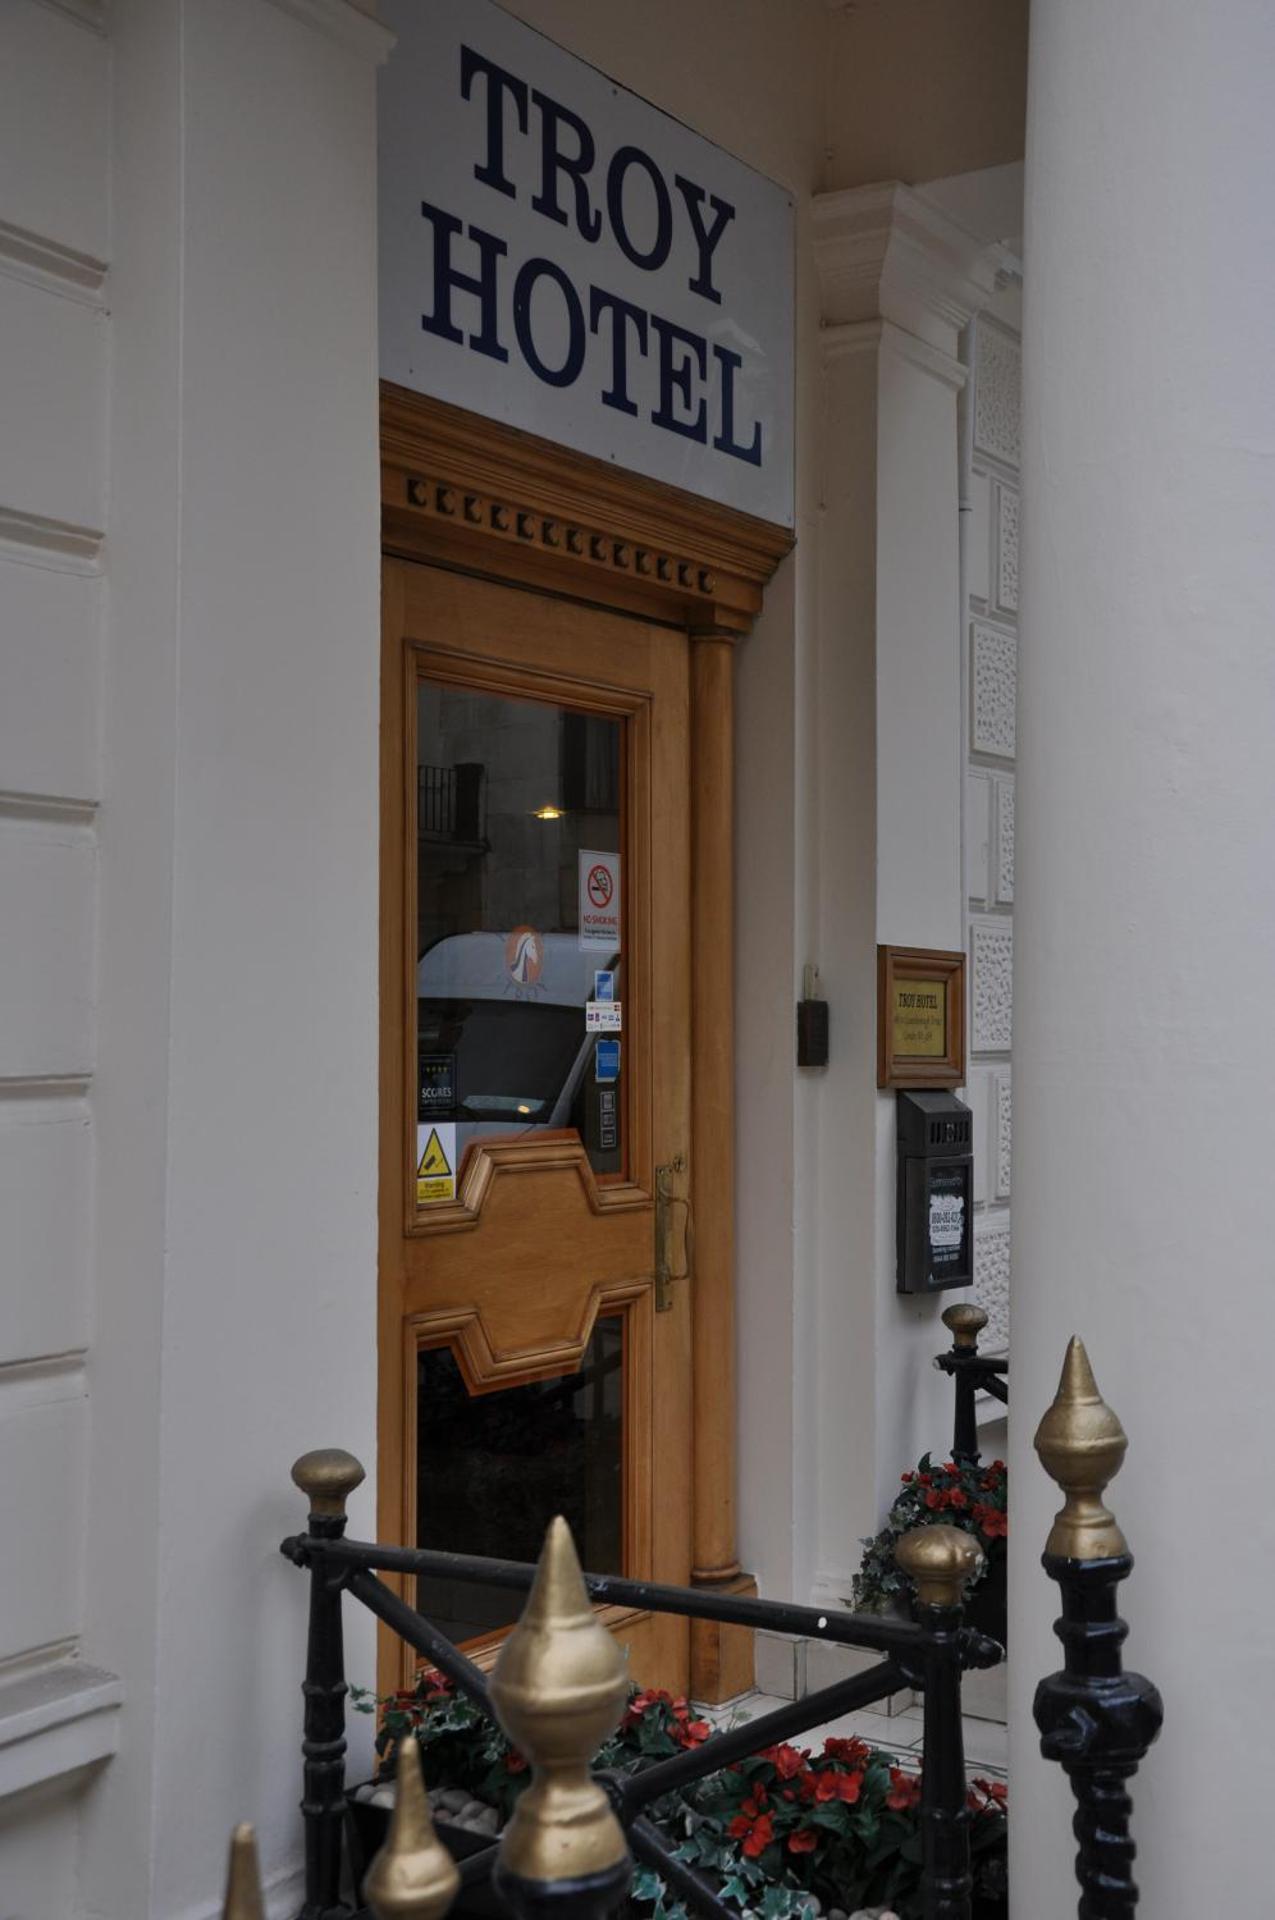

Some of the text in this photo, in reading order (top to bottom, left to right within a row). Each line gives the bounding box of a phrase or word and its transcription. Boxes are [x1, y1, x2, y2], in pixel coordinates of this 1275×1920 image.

[460, 43, 735, 305] TROY
[421, 200, 762, 467] HOTEL
[899, 992, 938, 1009] TROY HOTEL
[421, 1088, 452, 1098] SCORES
